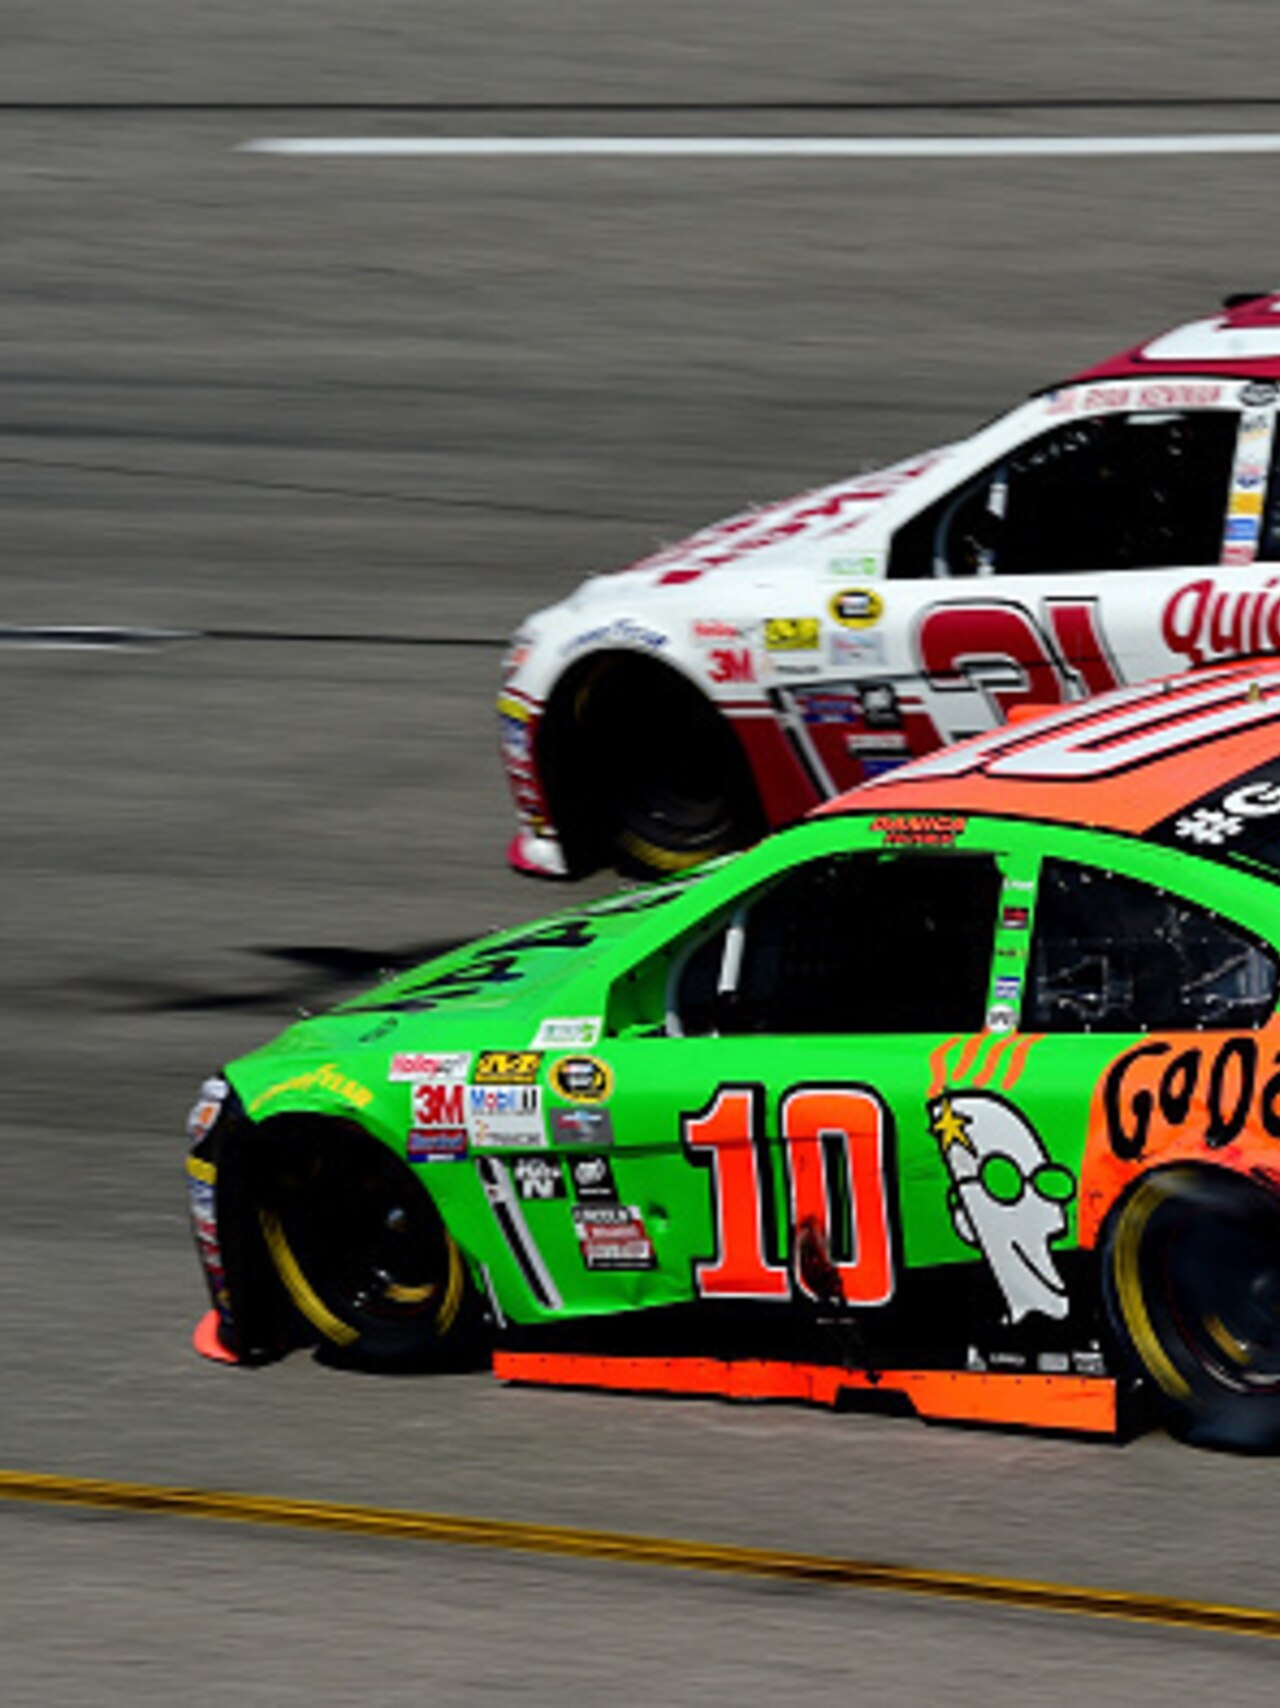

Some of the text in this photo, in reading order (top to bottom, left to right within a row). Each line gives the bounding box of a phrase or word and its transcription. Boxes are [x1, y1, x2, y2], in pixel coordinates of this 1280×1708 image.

[708, 650, 757, 683] 3M
[414, 1084, 465, 1125] 3M
[680, 1083, 900, 1309] 10
